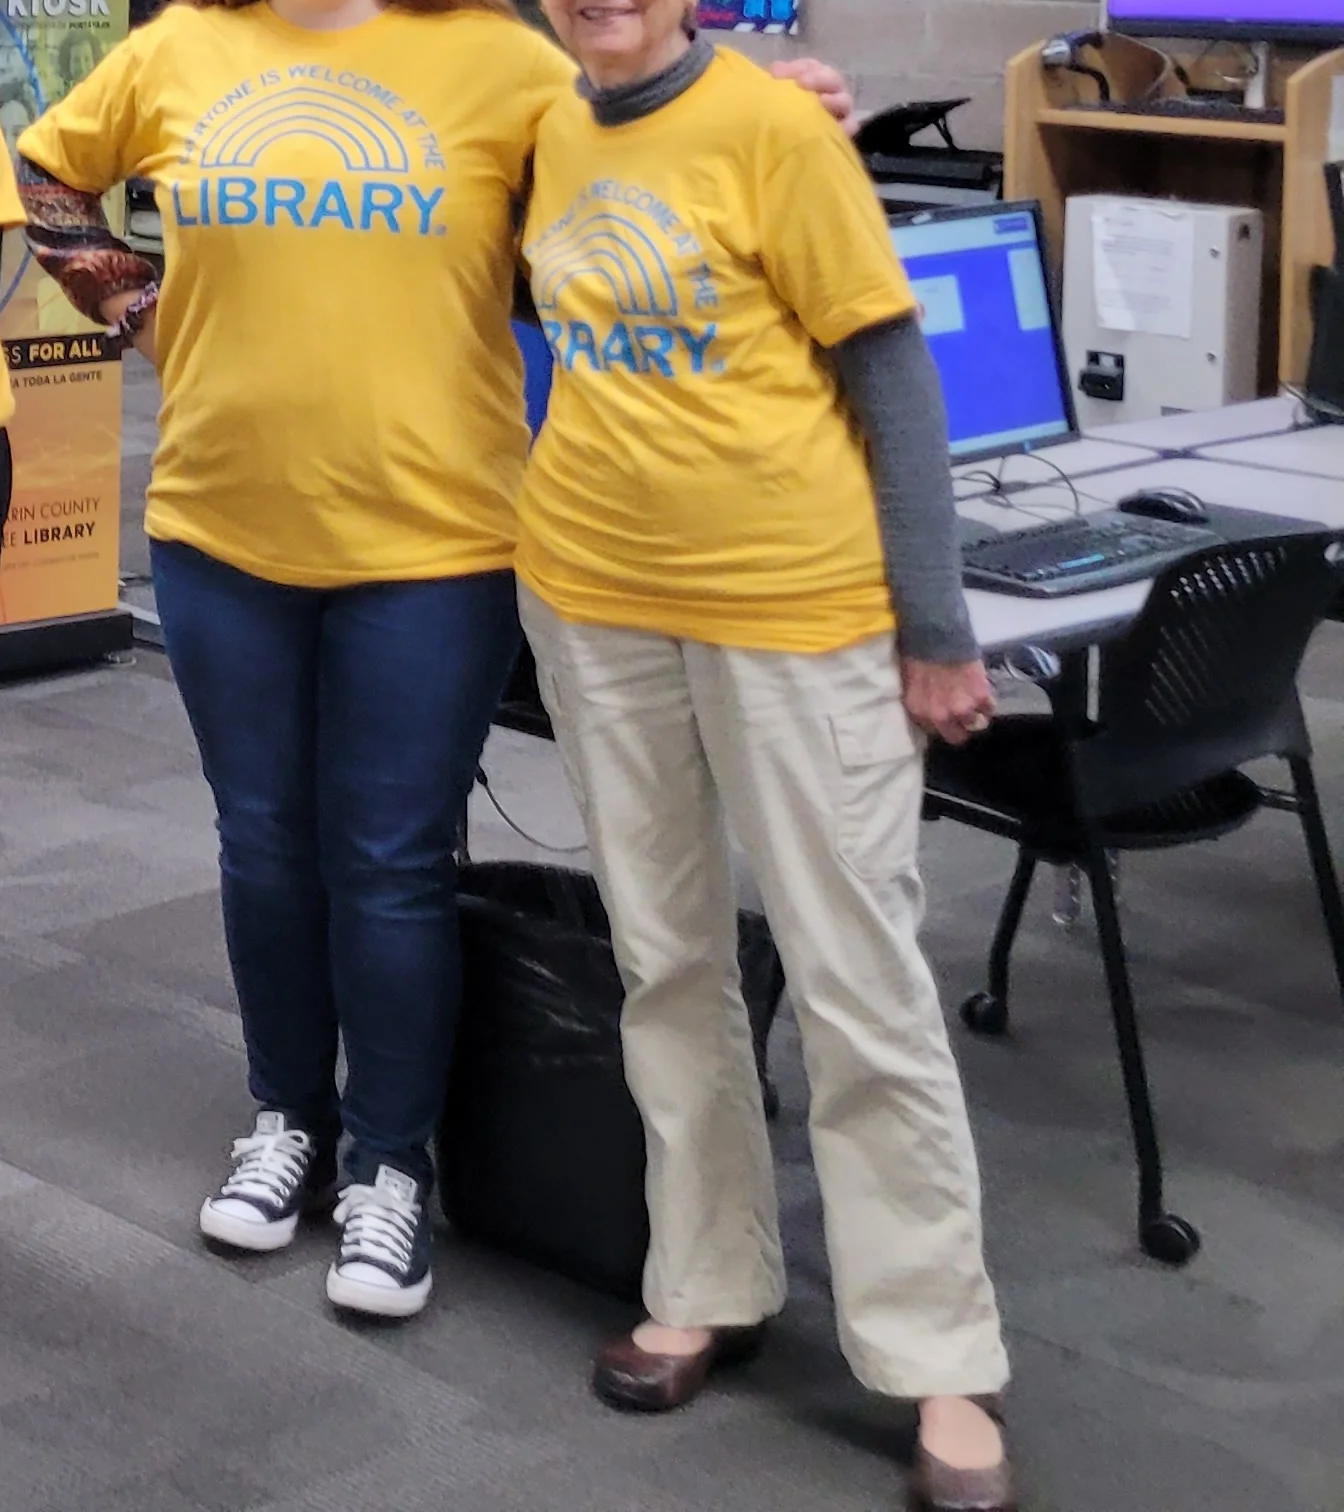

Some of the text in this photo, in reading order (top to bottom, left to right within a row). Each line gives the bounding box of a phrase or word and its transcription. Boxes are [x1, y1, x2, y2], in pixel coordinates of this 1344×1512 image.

[260, 70, 280, 87] IS
[288, 64, 406, 110] WELCOME
[401, 110, 428, 130] AT
[416, 133, 446, 171] THE
[172, 177, 445, 235] LIBRARY
[29, 342, 65, 363] FOR
[69, 339, 102, 358] ALL
[23, 375, 50, 388] TODA
[54, 374, 66, 384] LA
[70, 370, 102, 382] GENTE
[7, 496, 100, 523] RIN COUNTY
[24, 521, 95, 545] LIBRARY
